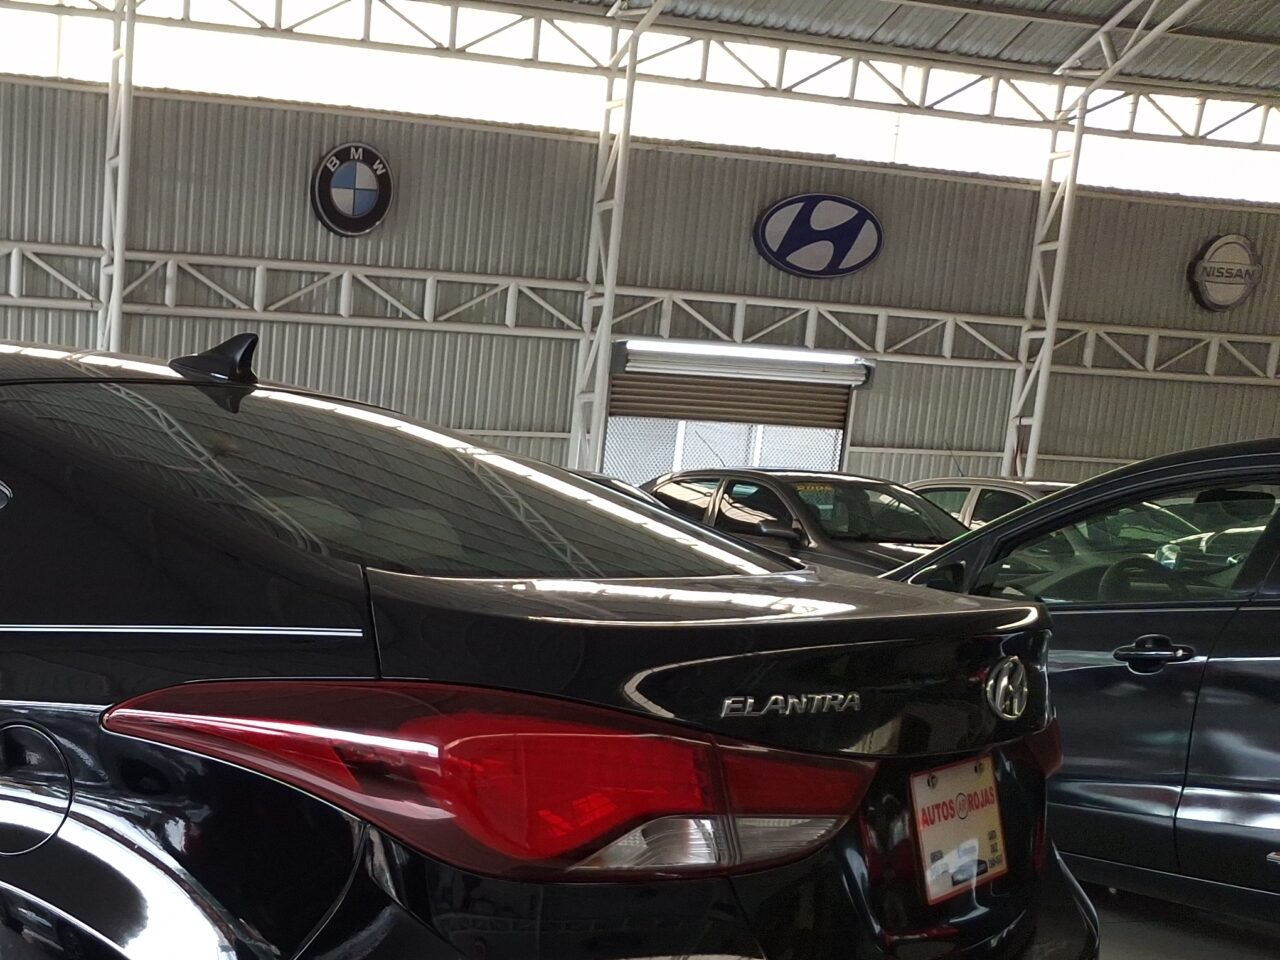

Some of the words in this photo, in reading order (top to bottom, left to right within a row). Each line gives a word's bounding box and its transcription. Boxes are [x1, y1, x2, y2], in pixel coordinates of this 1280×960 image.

[326, 147, 386, 176] BMW
[1201, 266, 1256, 280] NISSAN
[720, 691, 861, 720] ELANTRA
[920, 798, 956, 829] AUTOS
[967, 786, 995, 813] ROJAS
